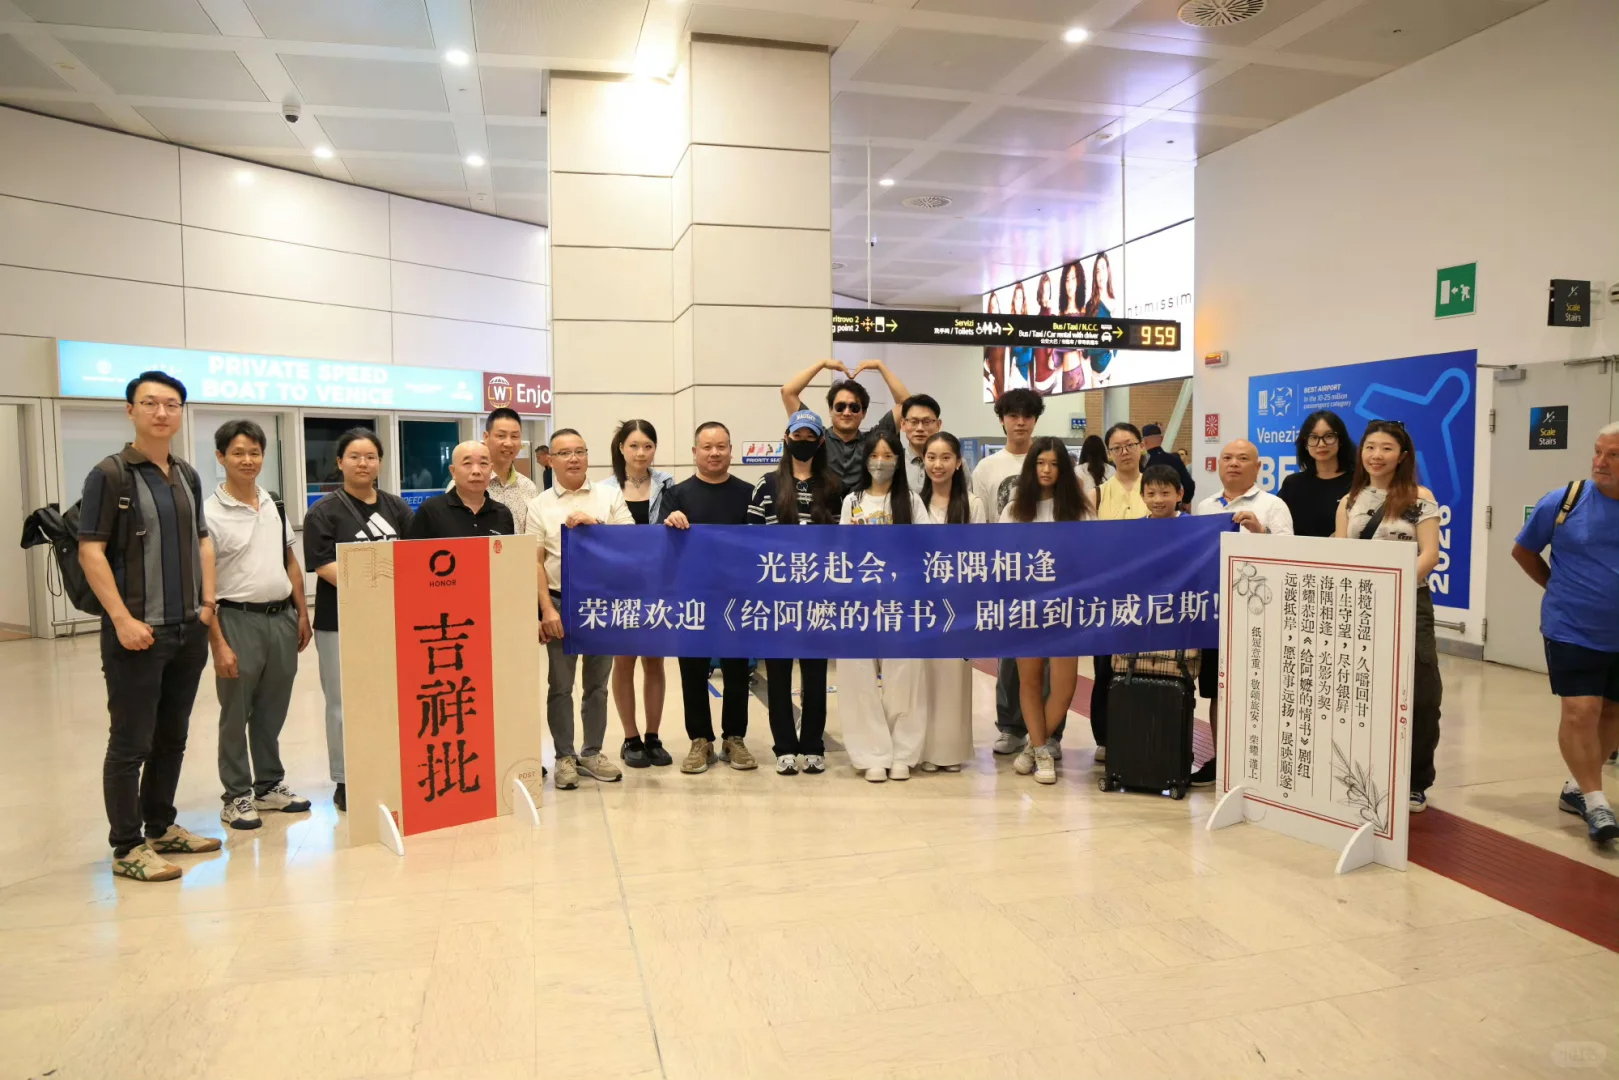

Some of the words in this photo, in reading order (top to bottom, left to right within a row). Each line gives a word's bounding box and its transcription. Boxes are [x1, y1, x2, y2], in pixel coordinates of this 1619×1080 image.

[1565, 312, 1582, 322] Stairs
[955, 319, 974, 327] Servizi
[1053, 322, 1063, 330] Bus
[837, 324, 854, 333] point
[954, 327, 974, 336] Toilets
[1032, 330, 1043, 338] Taxi
[1056, 331, 1072, 339] rental
[1072, 331, 1084, 339] with
[207, 354, 310, 380] PRIVATE
[318, 364, 388, 384] SPEED
[202, 378, 270, 400] BOAT
[276, 382, 309, 401] TO
[315, 385, 395, 405] VENICE
[1303, 386, 1317, 394] BEST
[1318, 384, 1341, 392] AIRPORT
[1330, 400, 1352, 408] category
[1540, 428, 1556, 437] Scale
[1539, 437, 1557, 446] Stairs
[429, 579, 457, 588] HONOR
[413, 612, 481, 802] 吉祥批
[518, 771, 536, 780] POST
